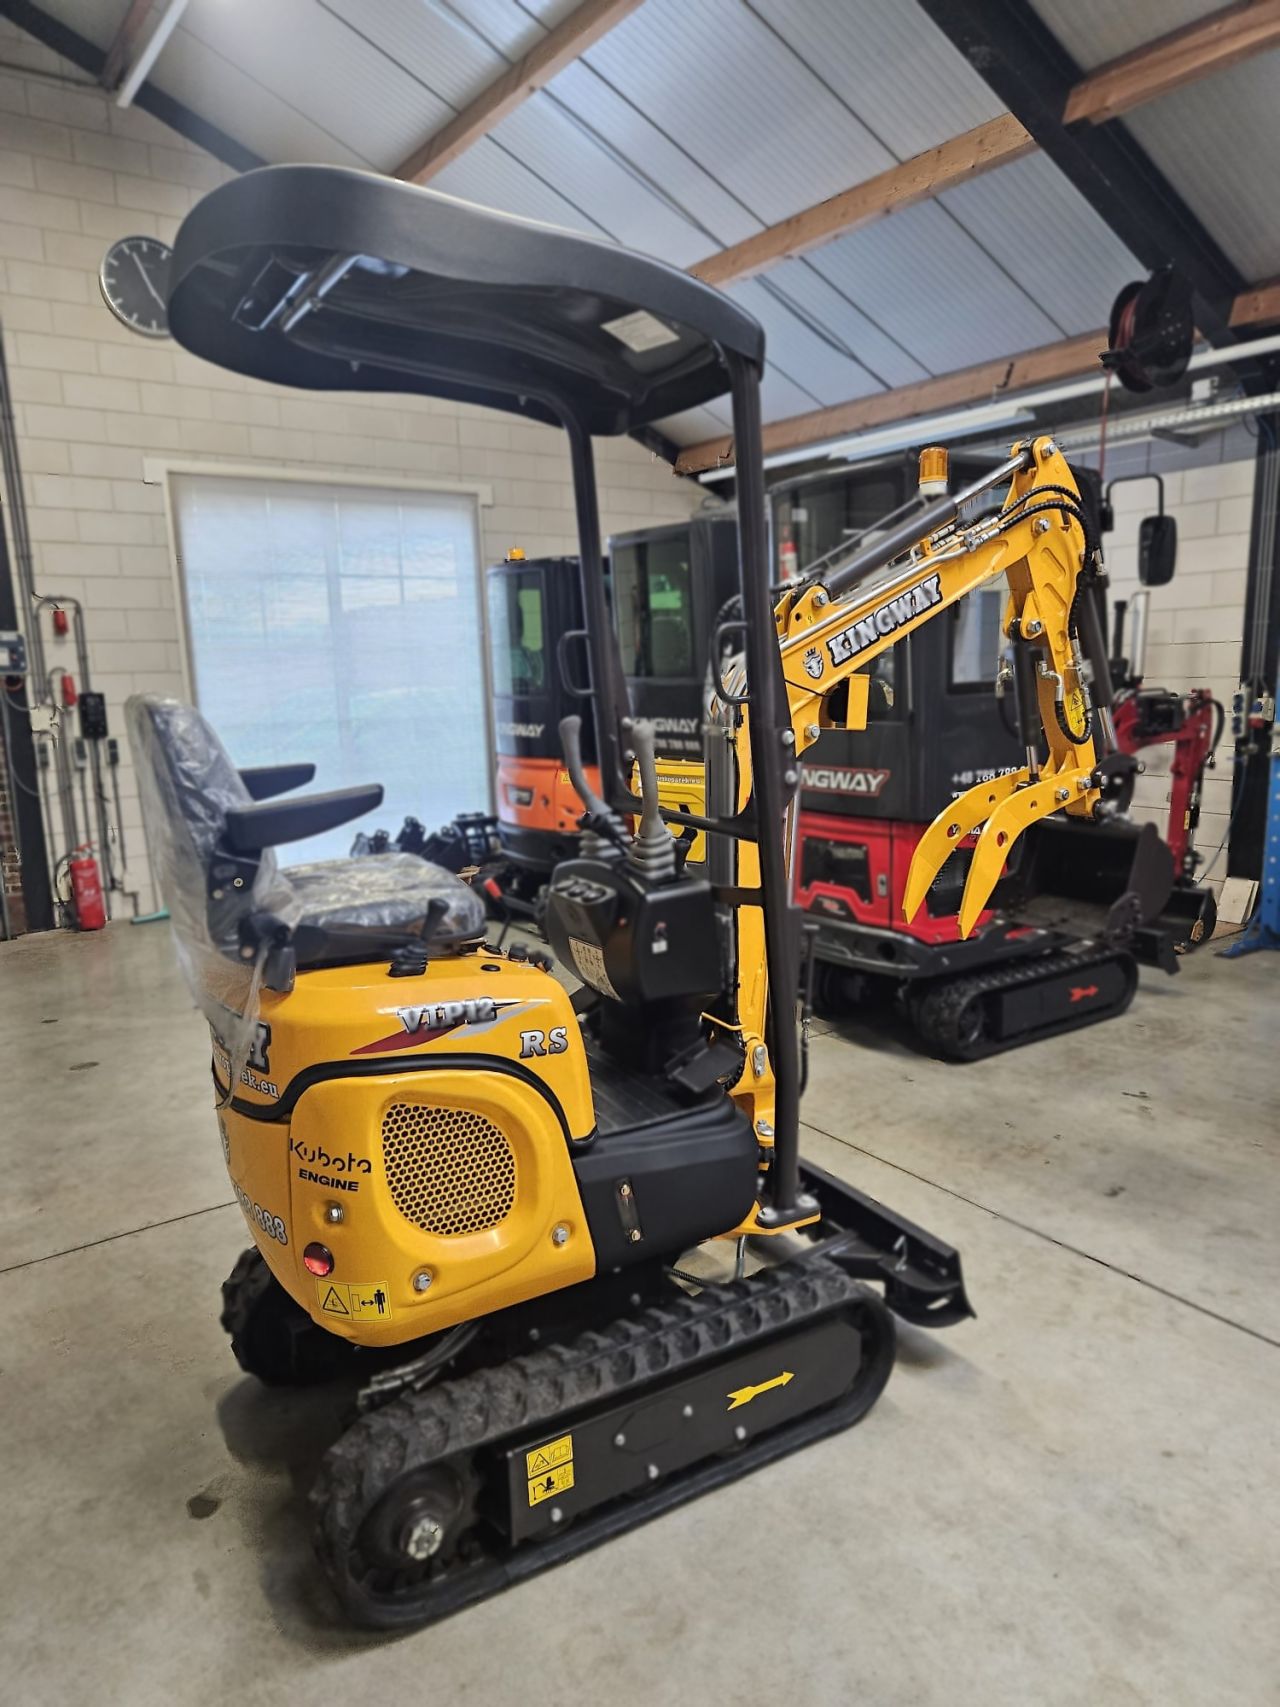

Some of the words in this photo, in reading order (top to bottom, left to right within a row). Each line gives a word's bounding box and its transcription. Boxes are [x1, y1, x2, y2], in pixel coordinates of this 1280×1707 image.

[826, 573, 943, 668] KINGWAY
[801, 768, 883, 793] NGWAY
[519, 1027, 569, 1059] RS
[289, 1138, 372, 1174] Kubota
[298, 1168, 360, 1192] ENGINE
